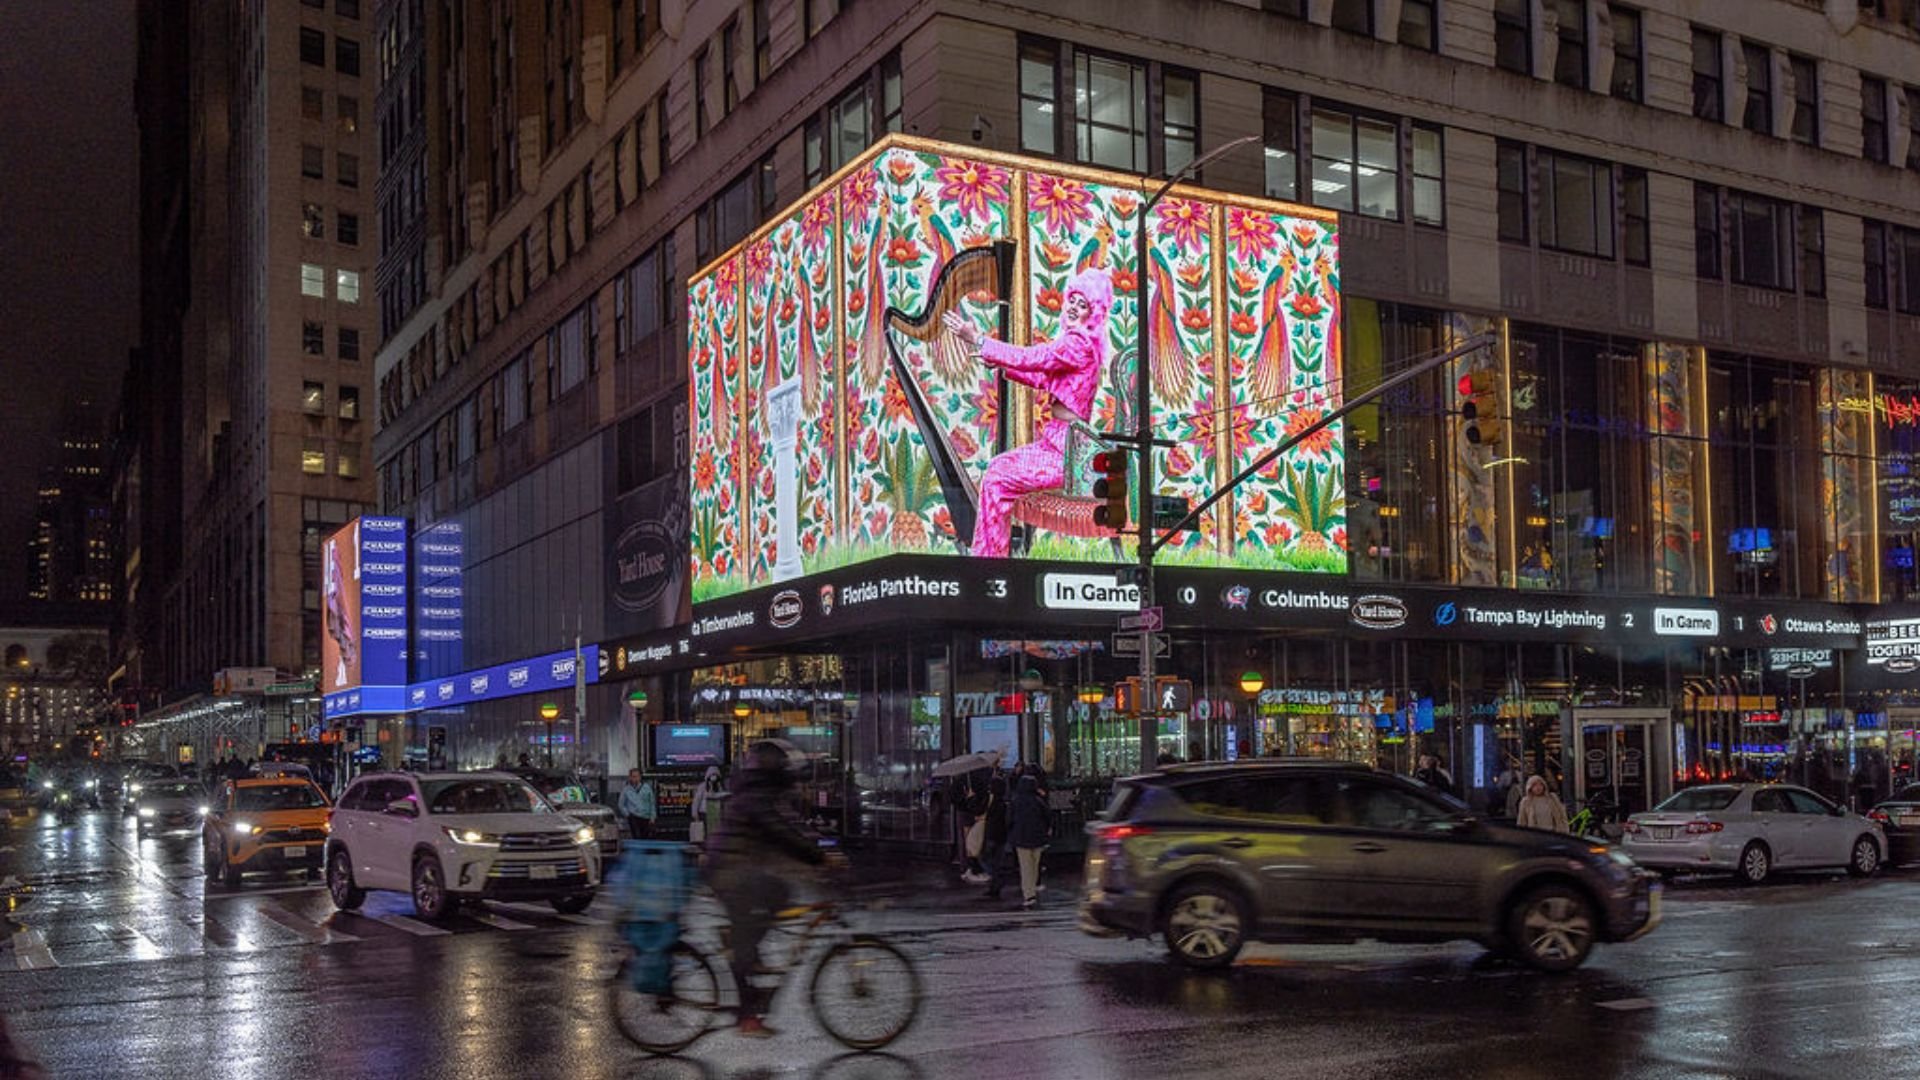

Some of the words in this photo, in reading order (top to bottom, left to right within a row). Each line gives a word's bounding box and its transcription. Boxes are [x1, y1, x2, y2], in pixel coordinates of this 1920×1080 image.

[638, 551, 665, 579] House
[842, 582, 878, 606] Florida
[881, 575, 960, 598] Panthers
[993, 580, 1007, 598] 3
[1056, 582, 1075, 600] In
[1081, 584, 1139, 602] Game
[1184, 587, 1196, 604] 0
[1265, 590, 1349, 609] Columbus
[701, 610, 754, 635] Timberwolves
[1468, 608, 1514, 626] Tampa
[1516, 610, 1543, 627] Bay
[1544, 609, 1606, 629] Lightning
[1624, 613, 1634, 627] 2
[1661, 614, 1673, 627] In
[1677, 615, 1713, 630] Game
[1785, 619, 1824, 633] Ottawa
[648, 644, 672, 660] Nuggets
